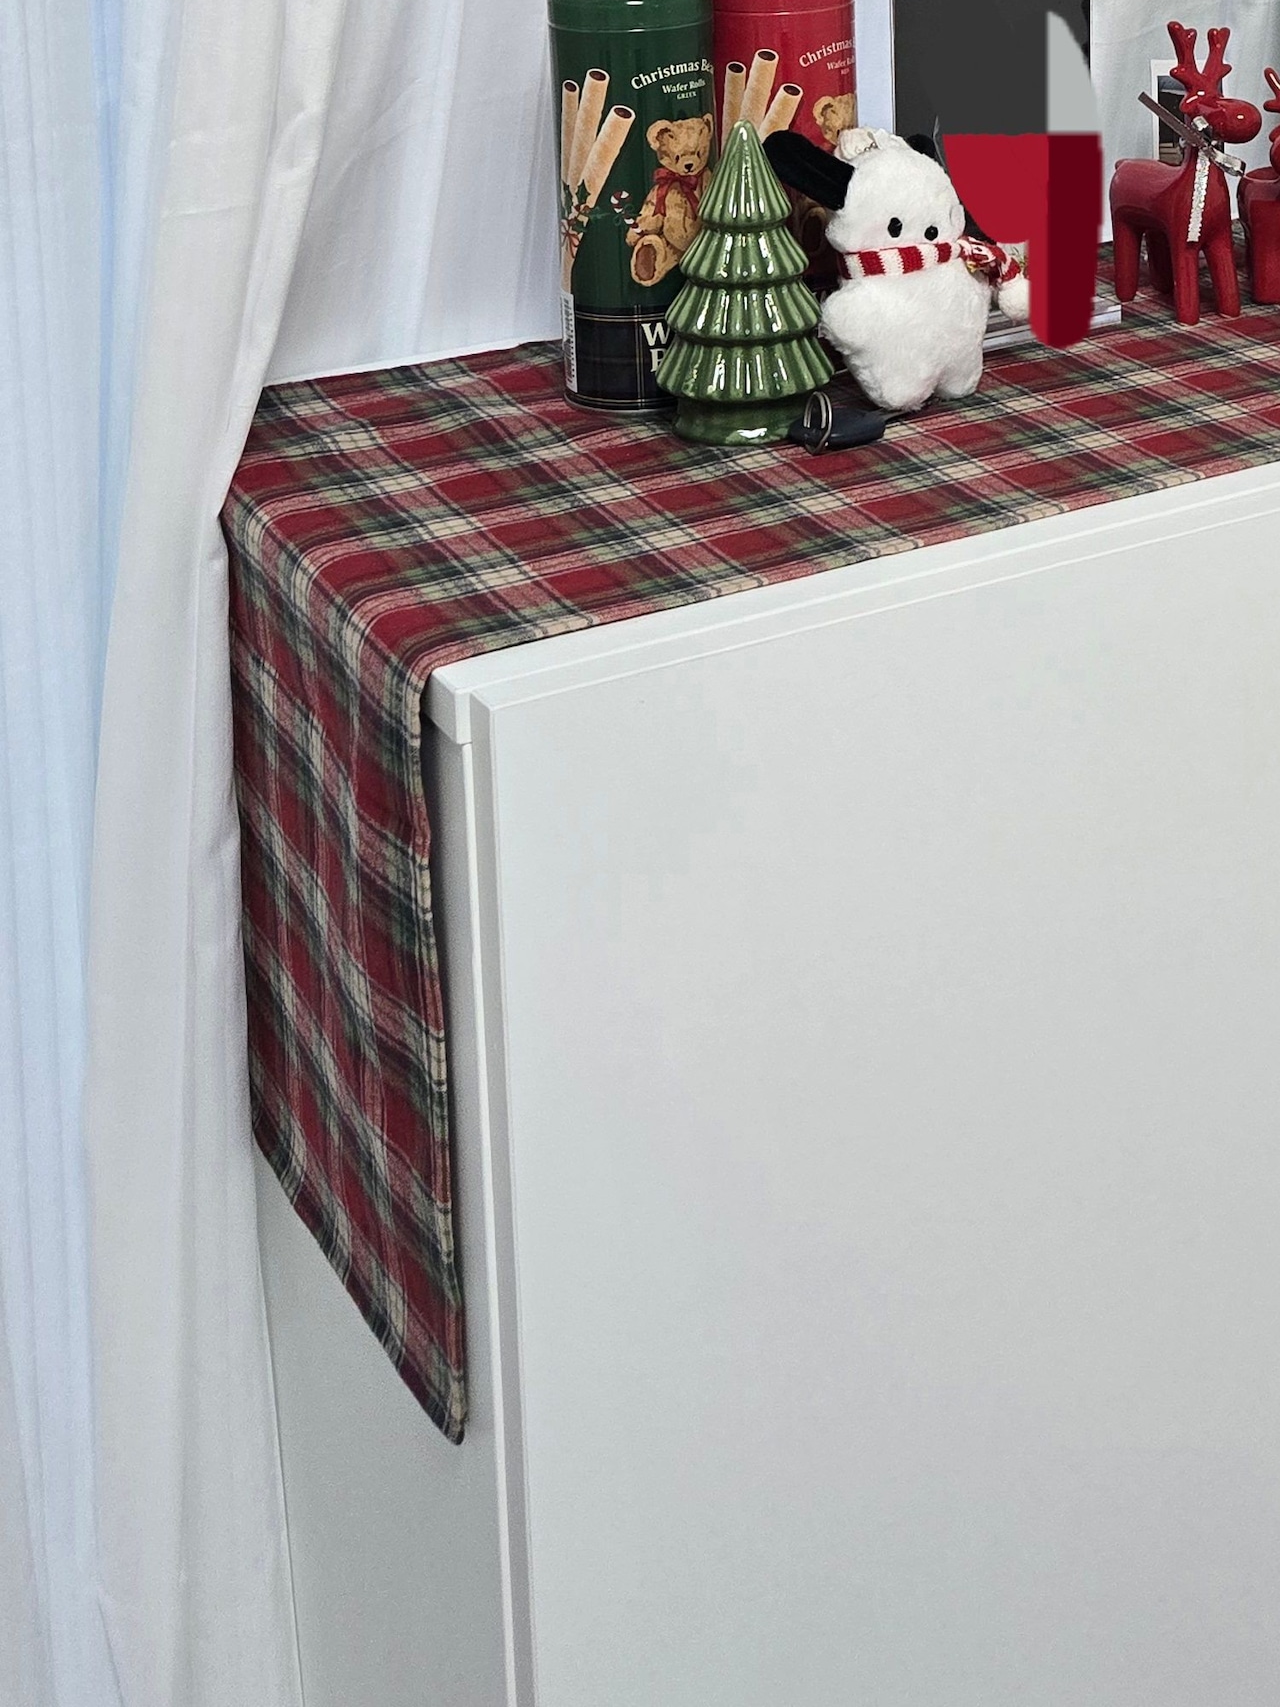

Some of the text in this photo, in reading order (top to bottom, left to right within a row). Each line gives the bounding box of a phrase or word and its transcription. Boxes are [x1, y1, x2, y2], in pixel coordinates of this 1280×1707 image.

[799, 38, 852, 68] Christmas
[630, 61, 700, 90] Christmas
[661, 78, 706, 94] Wafer Rolls
